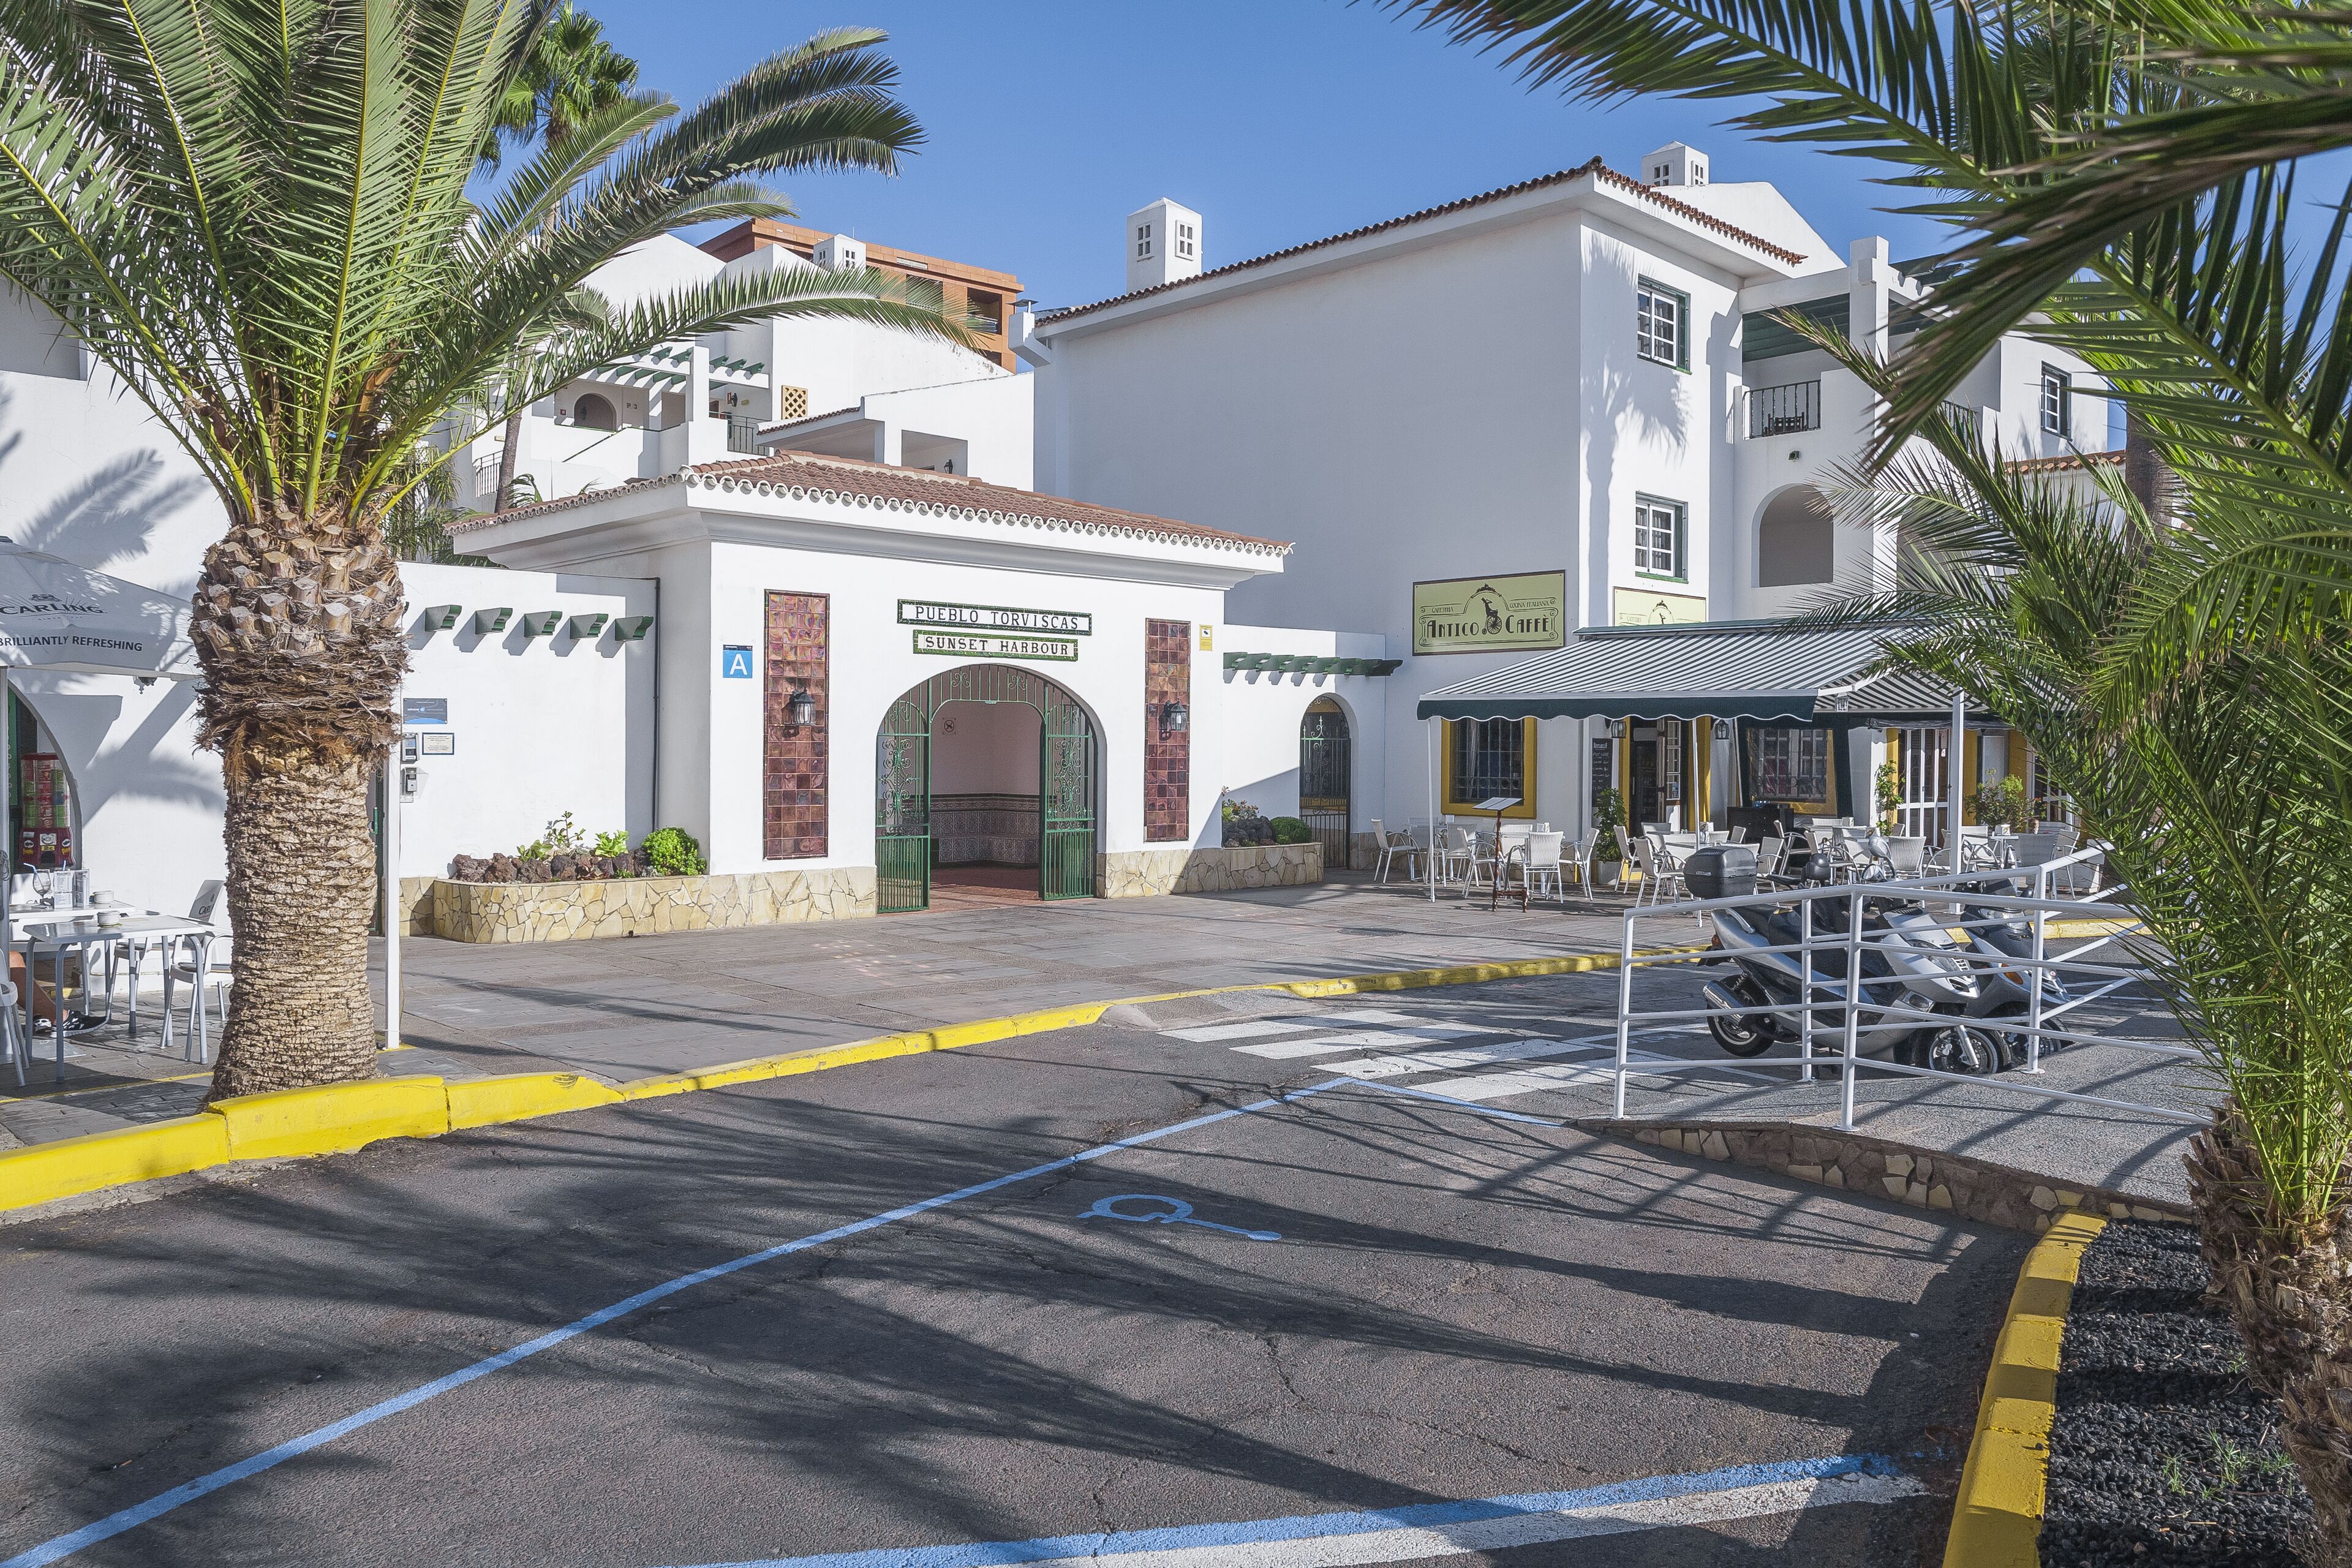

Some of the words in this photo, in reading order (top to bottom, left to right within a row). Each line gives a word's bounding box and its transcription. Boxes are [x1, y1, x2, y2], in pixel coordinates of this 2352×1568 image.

[0, 603, 104, 615] CARLING
[915, 606, 978, 623] PUEBLO
[990, 611, 1079, 630] TORVISCAS
[1427, 620, 1479, 638] ANTICO
[1505, 614, 1549, 633] CAFFÈ
[72, 635, 143, 652] REFRESHING
[925, 636, 989, 651] SUNSET
[1000, 640, 1069, 655] HARBOUR
[729, 653, 748, 675] A
